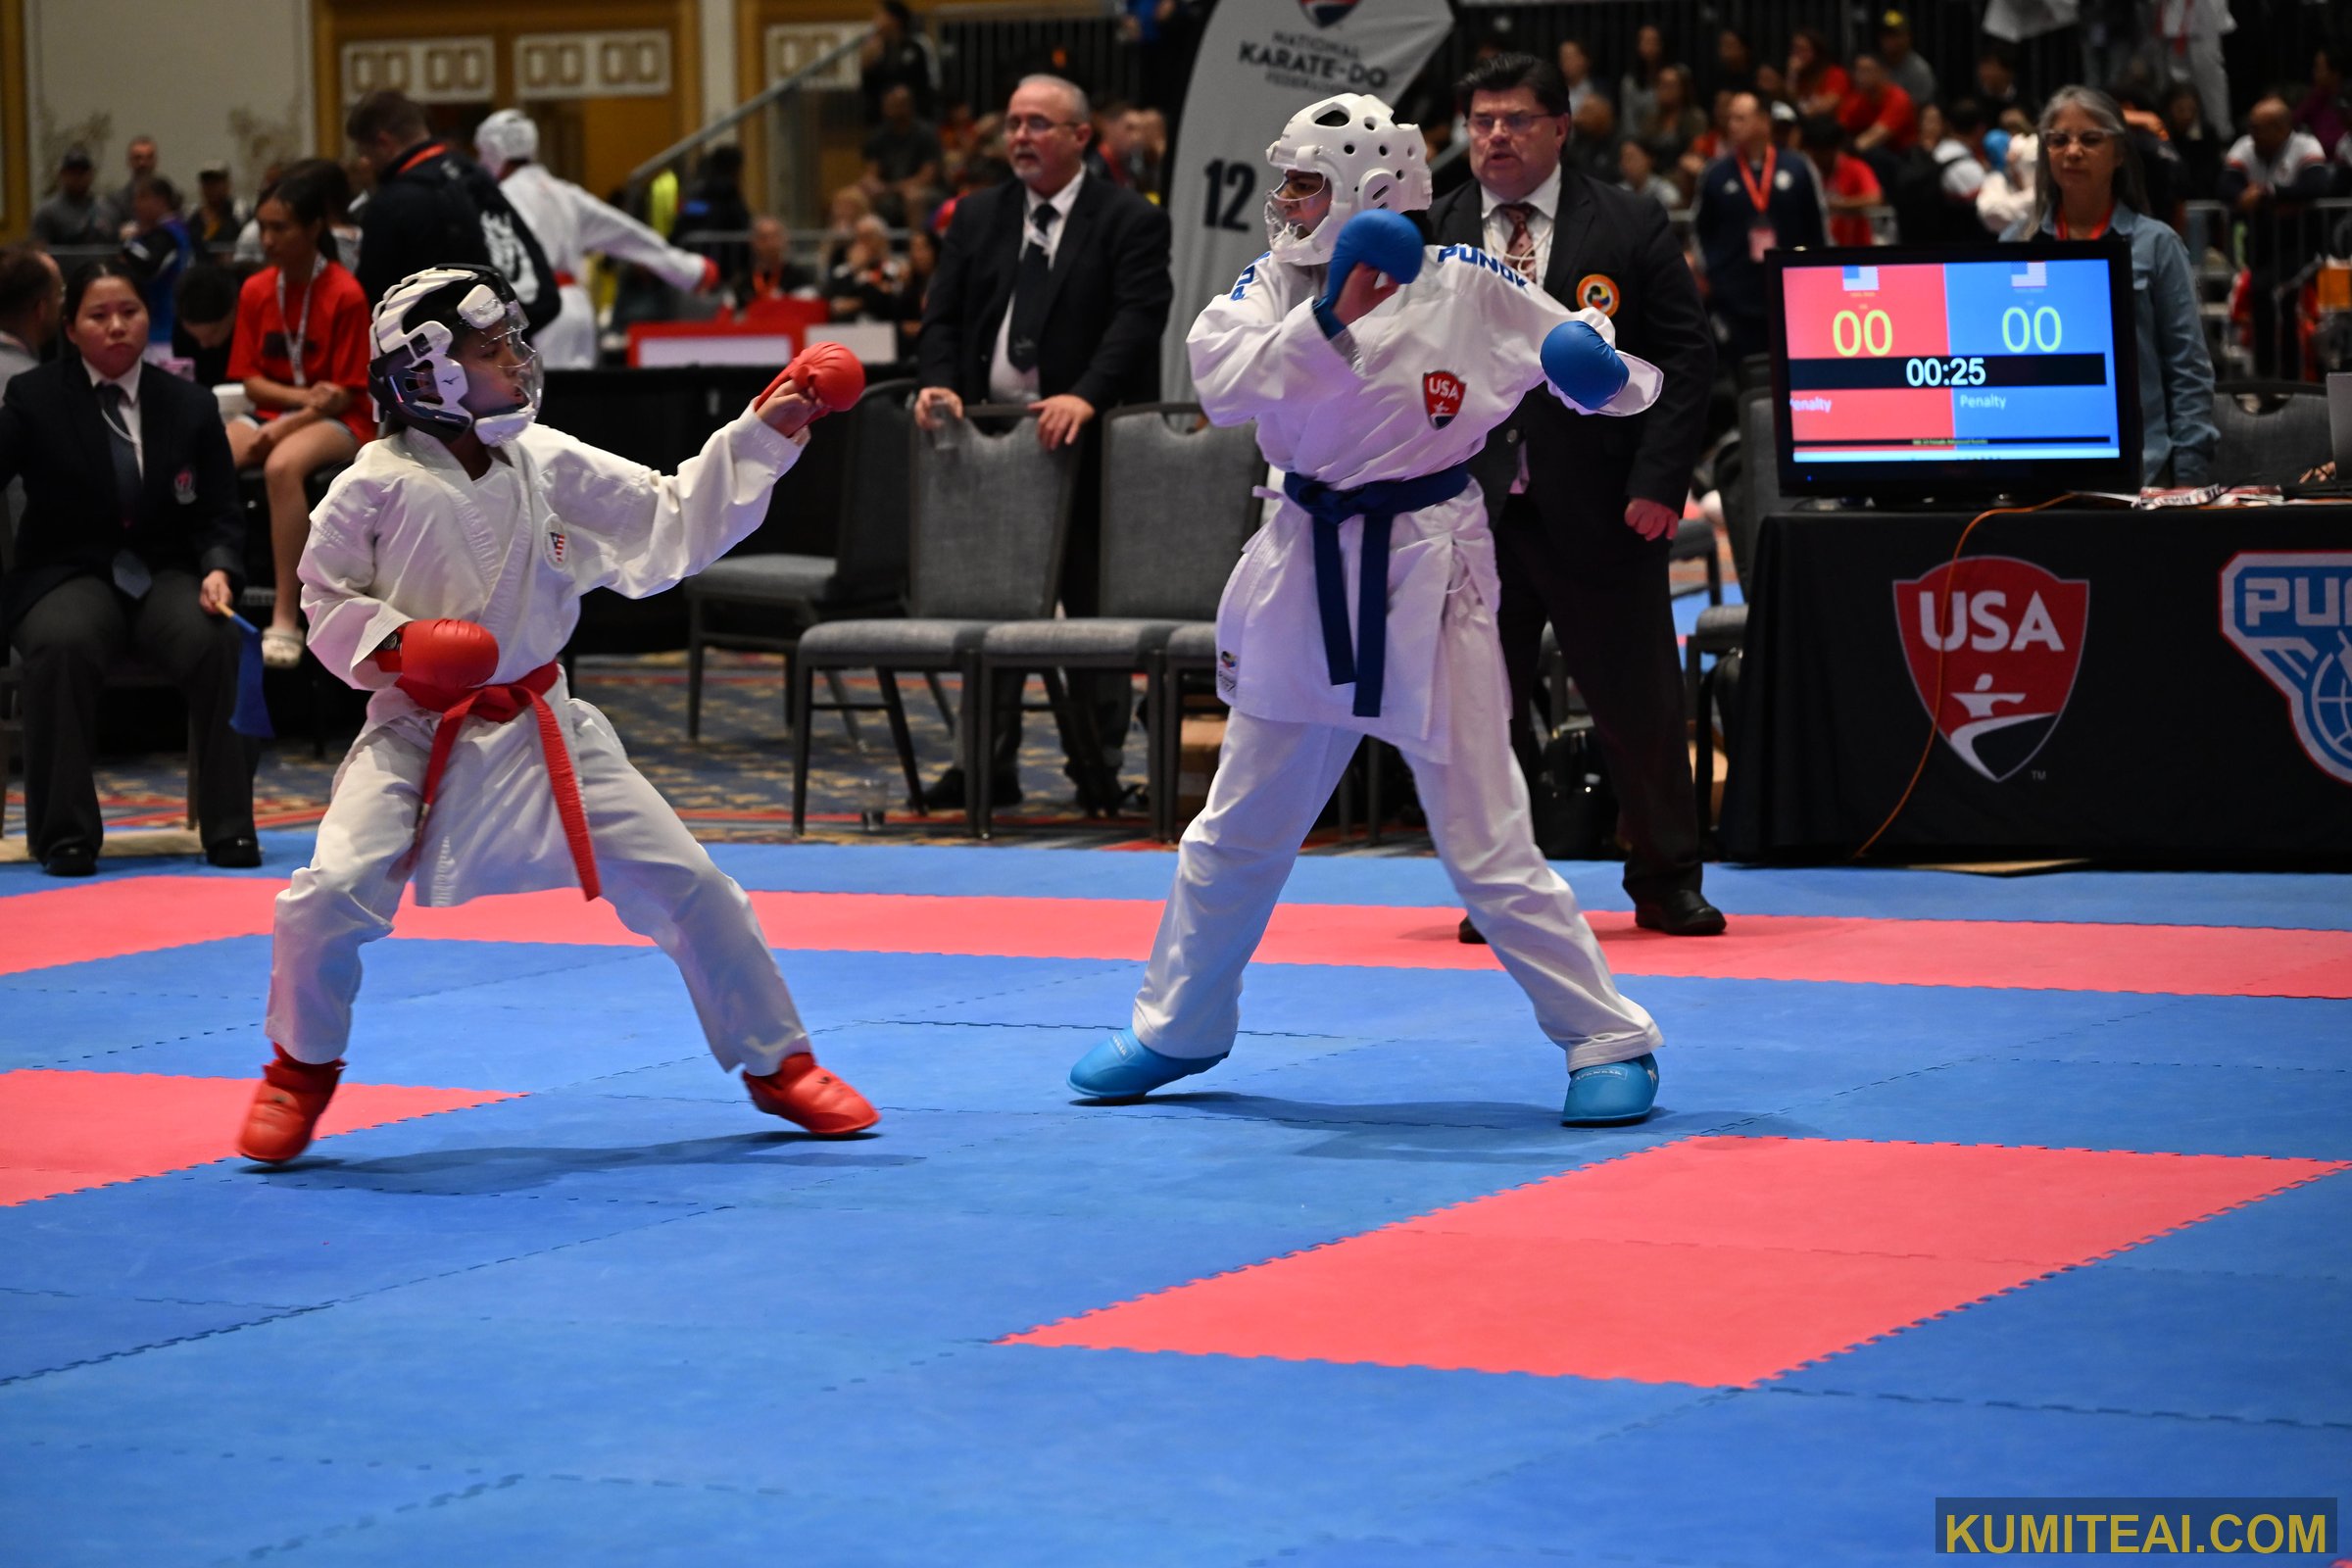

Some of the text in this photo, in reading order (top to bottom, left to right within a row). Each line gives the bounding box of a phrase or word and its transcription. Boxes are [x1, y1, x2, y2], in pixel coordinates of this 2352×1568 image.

[1238, 40, 1390, 89] KARATE-DO
[1203, 159, 1256, 232] 12
[1833, 309, 1893, 357] 00
[2001, 306, 2063, 353] 00
[1428, 376, 1459, 401] USA
[1906, 357, 1986, 386] 00:25
[1960, 393, 2006, 410] Penalty
[1919, 590, 2065, 653] USA
[2245, 577, 2352, 626] PU
